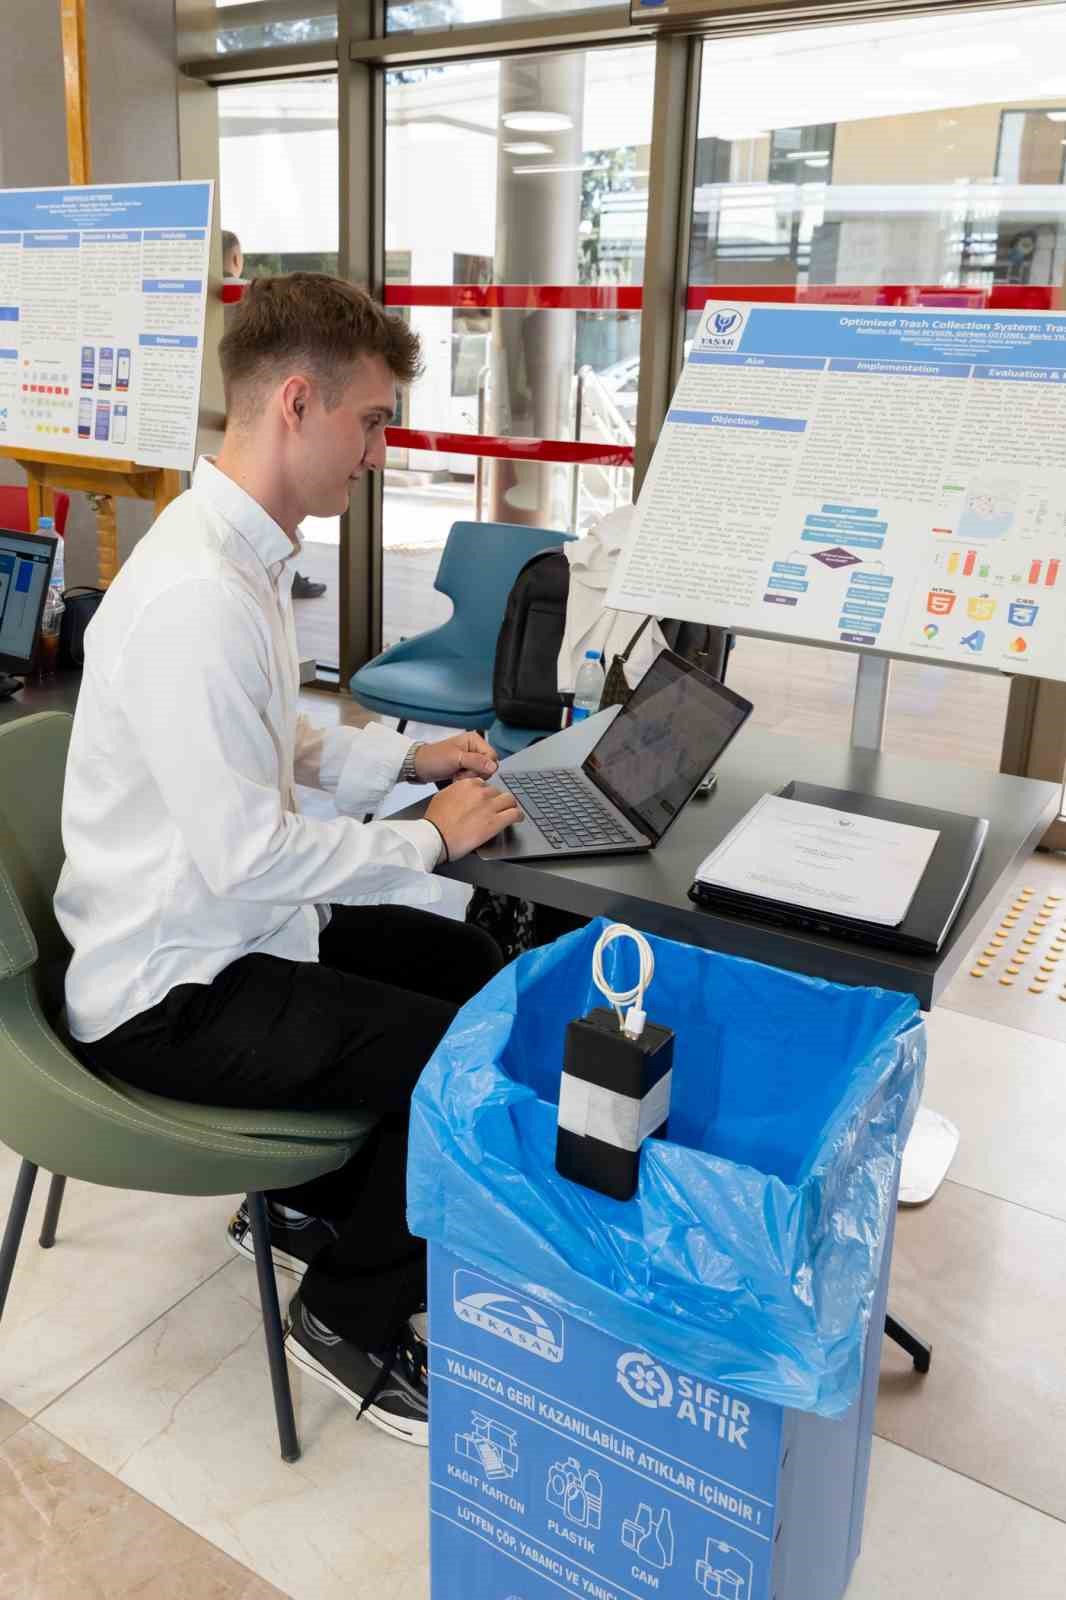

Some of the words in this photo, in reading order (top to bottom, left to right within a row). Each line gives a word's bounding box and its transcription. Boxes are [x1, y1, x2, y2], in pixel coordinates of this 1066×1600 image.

[839, 316, 896, 328] Optimized
[899, 318, 928, 329] Trash
[932, 319, 991, 331] Collection
[993, 321, 1041, 333] System:
[856, 361, 940, 374] Implementation
[988, 367, 1048, 379] Evaluation
[711, 415, 760, 427] Objectives
[677, 1375, 750, 1426] SIFIR
[447, 1359, 505, 1396] YALNIZCA
[507, 1386, 536, 1412] GERİ
[539, 1402, 635, 1462] KAZANILABİLİR
[637, 1452, 695, 1493] ATIKLAR
[700, 1479, 753, 1521] İÇİNDİR
[676, 1399, 750, 1450] ATIK
[481, 1480, 525, 1515] KARTON
[547, 1519, 596, 1554] PLASTİK
[519, 1541, 563, 1576] YABANCI
[565, 1567, 579, 1586] VE
[631, 1565, 660, 1590] CAM
